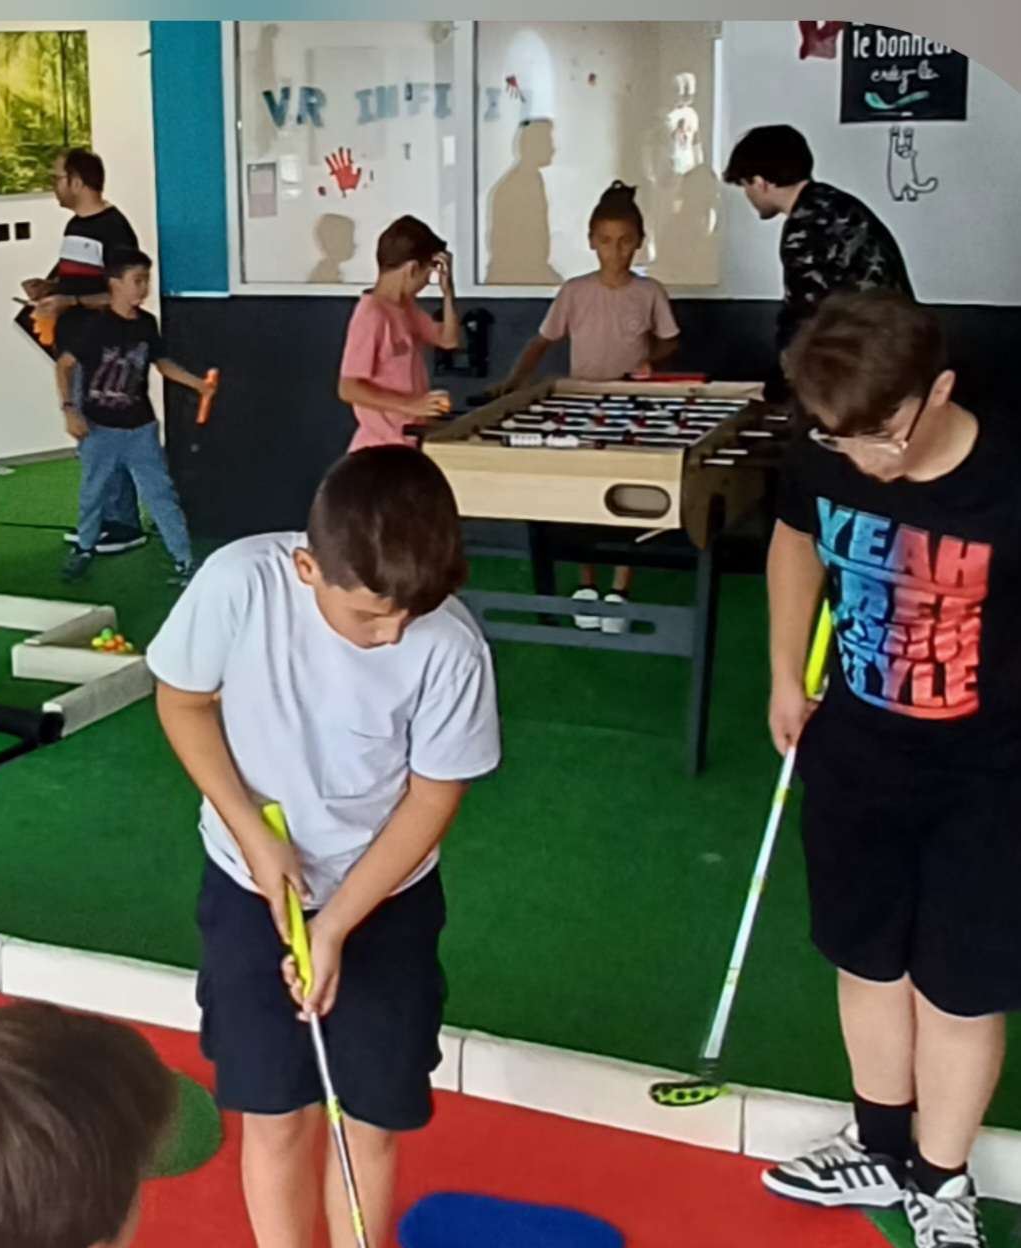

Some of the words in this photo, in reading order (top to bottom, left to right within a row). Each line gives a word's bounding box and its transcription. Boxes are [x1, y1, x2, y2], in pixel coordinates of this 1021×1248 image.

[852, 29, 871, 58] le
[262, 84, 328, 129] VR
[816, 496, 992, 592] YEAH
